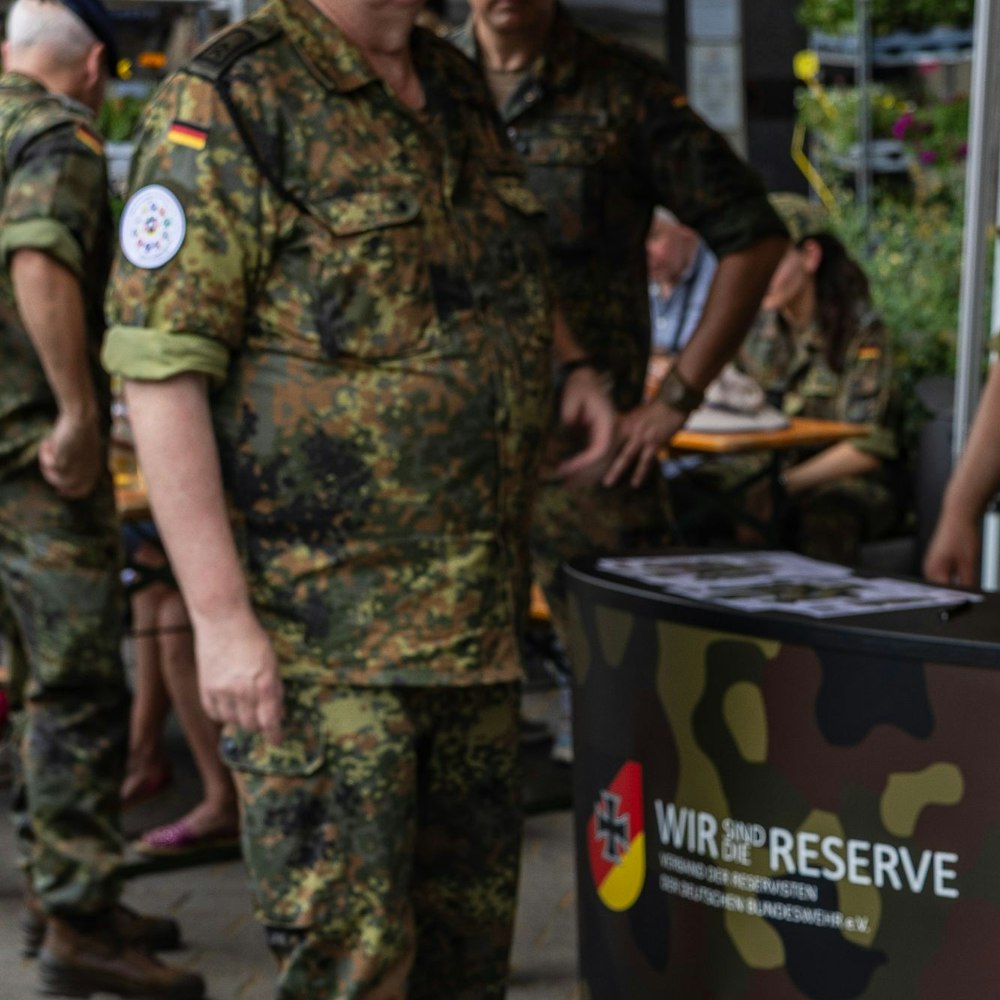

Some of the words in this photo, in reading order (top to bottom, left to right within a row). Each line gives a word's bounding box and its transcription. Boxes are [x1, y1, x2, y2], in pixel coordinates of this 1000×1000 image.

[654, 798, 719, 859] WIR
[721, 817, 766, 848] SIND
[769, 827, 959, 899] RESERVE
[721, 842, 752, 867] DIE
